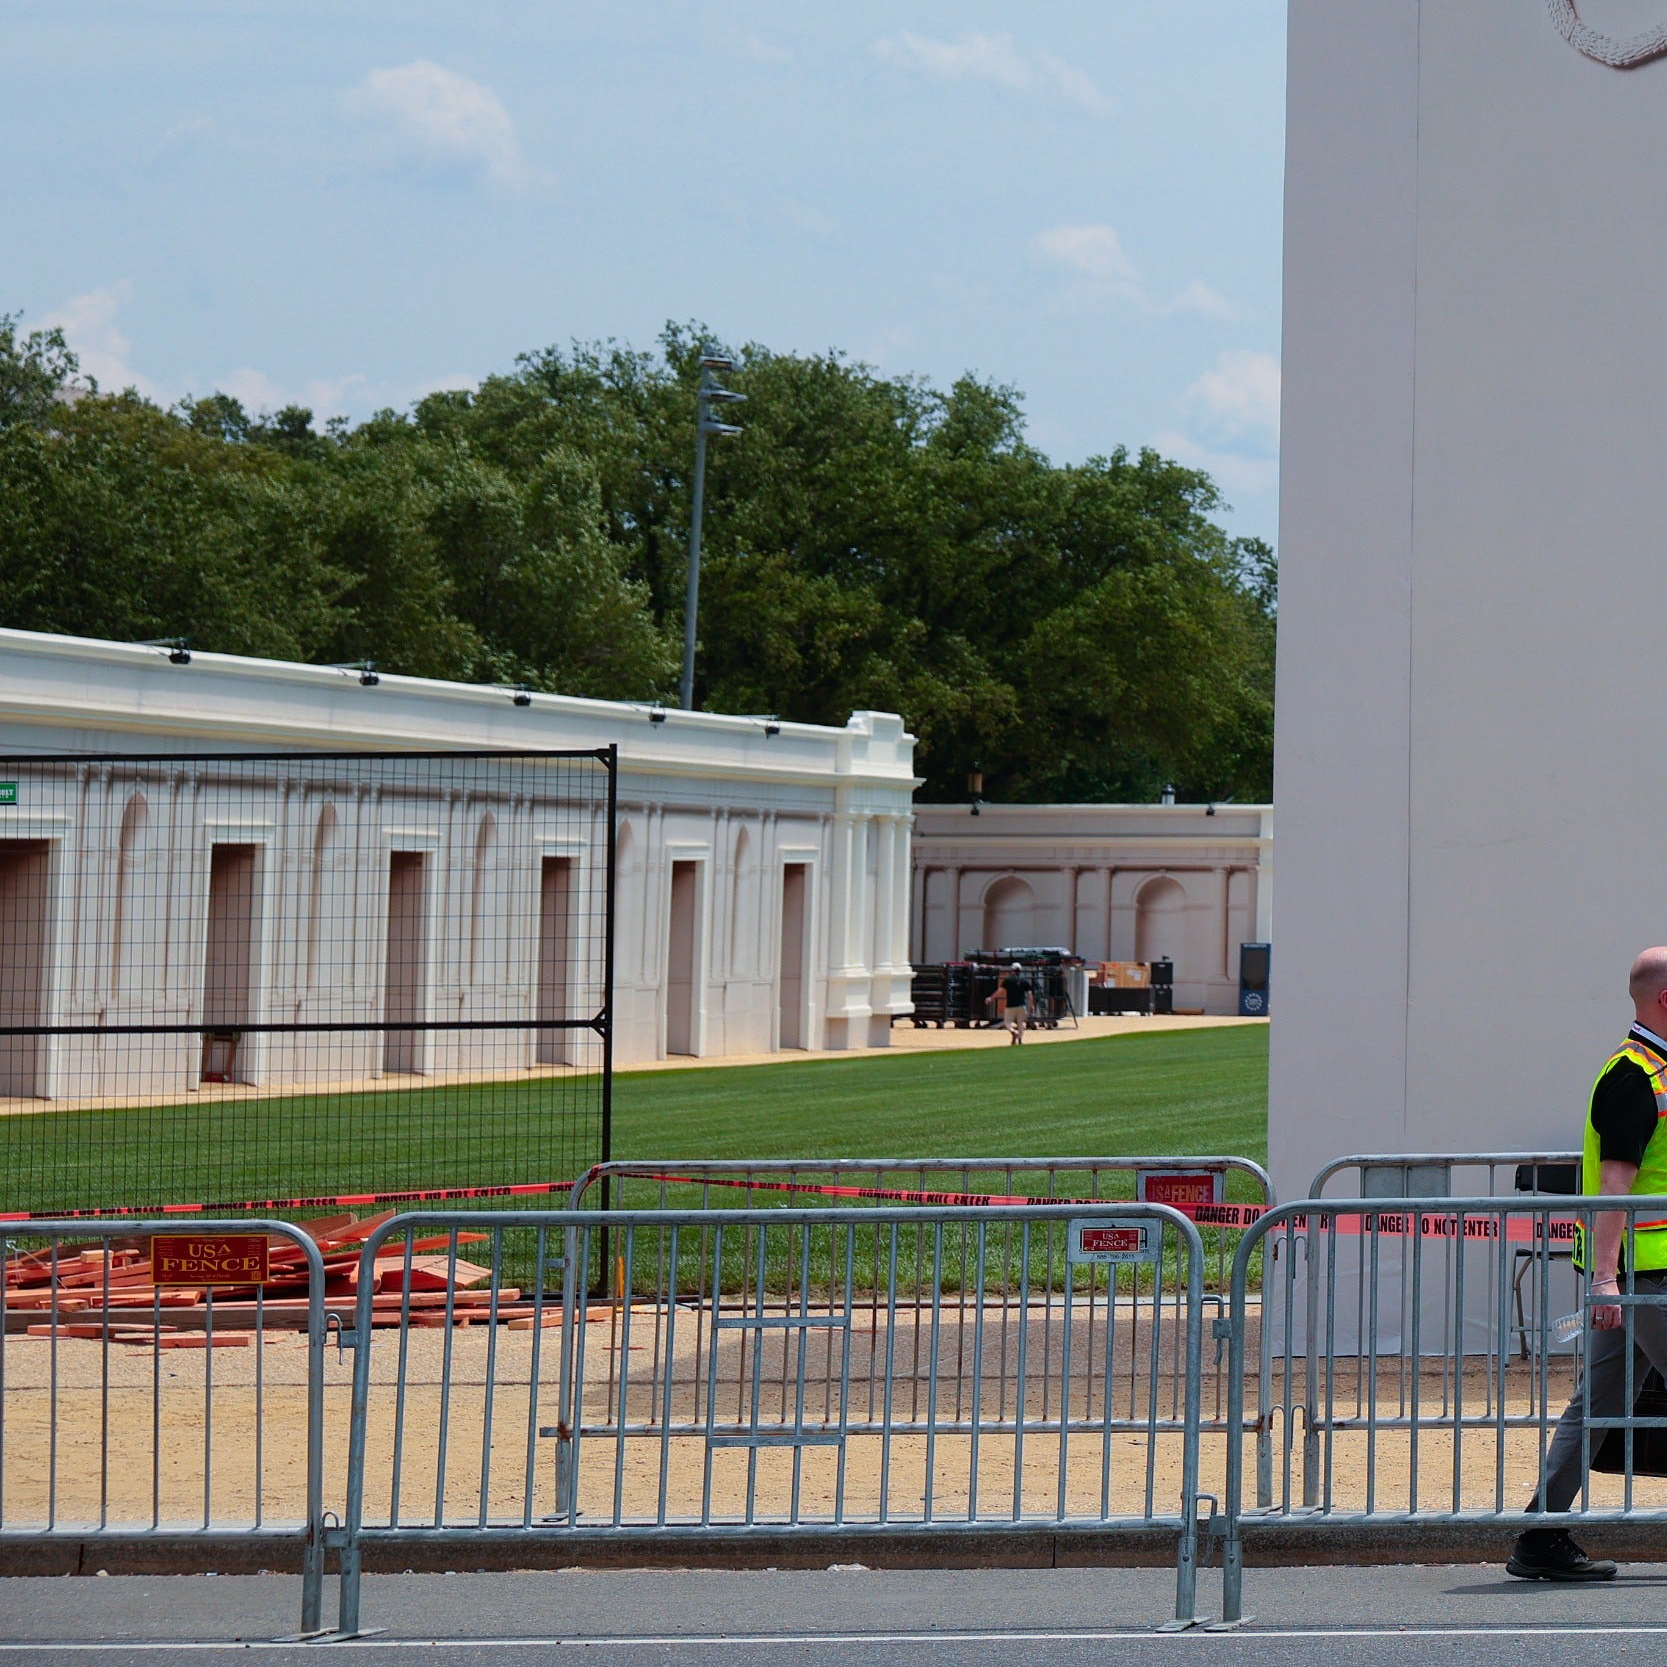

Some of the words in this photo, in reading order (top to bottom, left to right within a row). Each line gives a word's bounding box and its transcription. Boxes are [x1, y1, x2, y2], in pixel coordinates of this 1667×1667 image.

[1171, 1184, 1209, 1202] FENCE
[1195, 1205, 1239, 1224] DANGER
[1092, 1239, 1128, 1247] FENCE
[1102, 1233, 1120, 1241] USA
[188, 1243, 232, 1259] USA
[160, 1256, 260, 1272] FENCE
